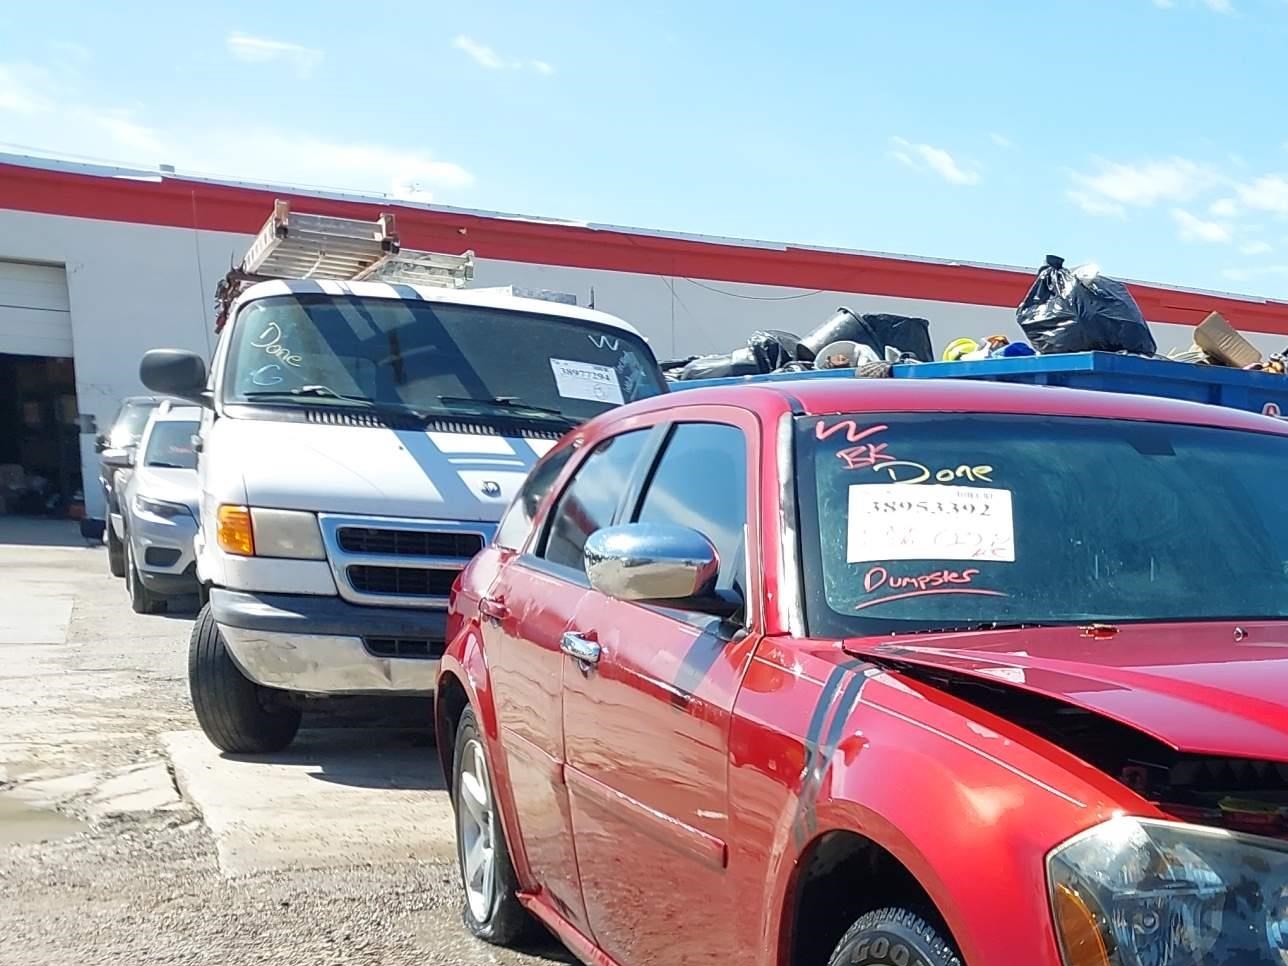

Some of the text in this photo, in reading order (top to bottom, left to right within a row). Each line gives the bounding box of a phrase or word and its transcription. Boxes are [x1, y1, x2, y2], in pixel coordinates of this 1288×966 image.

[250, 322, 302, 368] Done
[873, 461, 993, 484] Done
[867, 500, 991, 516] 38953392
